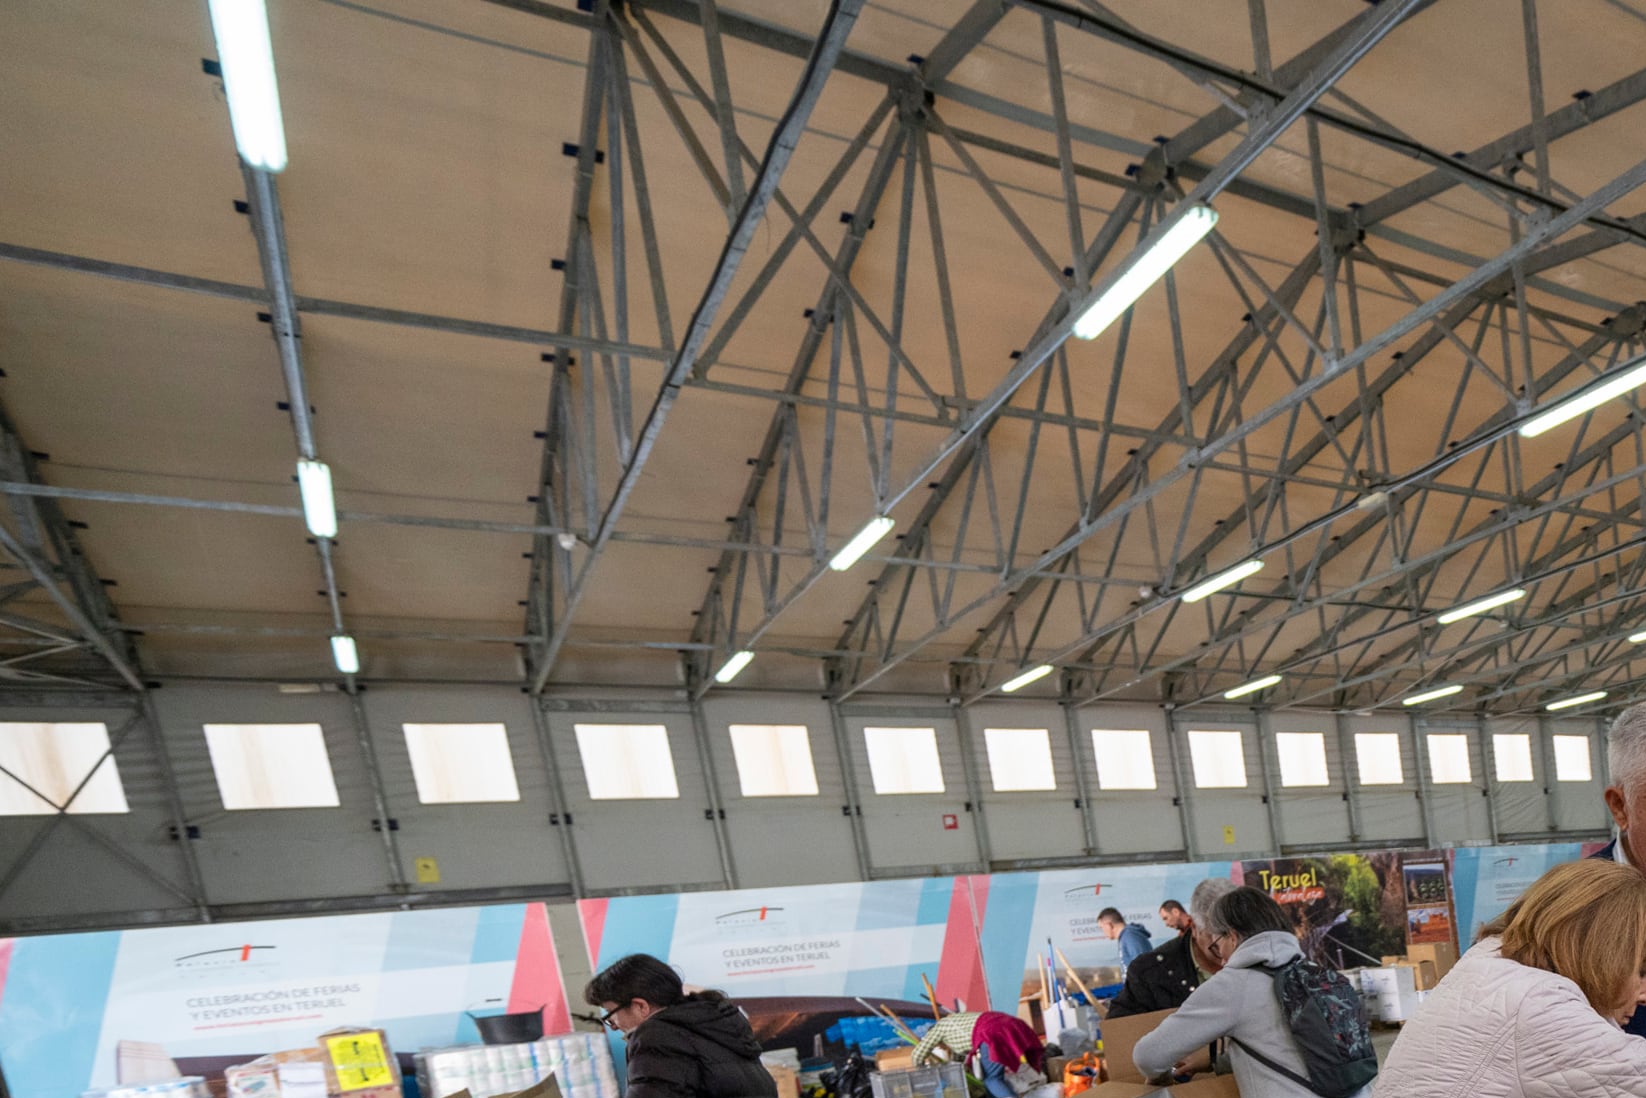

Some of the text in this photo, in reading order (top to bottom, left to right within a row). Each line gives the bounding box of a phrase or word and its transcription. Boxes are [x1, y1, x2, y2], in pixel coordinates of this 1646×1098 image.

[1258, 867, 1317, 890] Teruel
[722, 940, 840, 958] CELEBRACIÓN DE FERIAS
[733, 956, 779, 968] EVENTOS
[780, 954, 794, 963] EN
[796, 951, 831, 962] TERUEL
[186, 983, 361, 1008] CELEBRACIÓN DE FERIAS
[190, 998, 346, 1020] Y EVENTOS EN TERUEL
